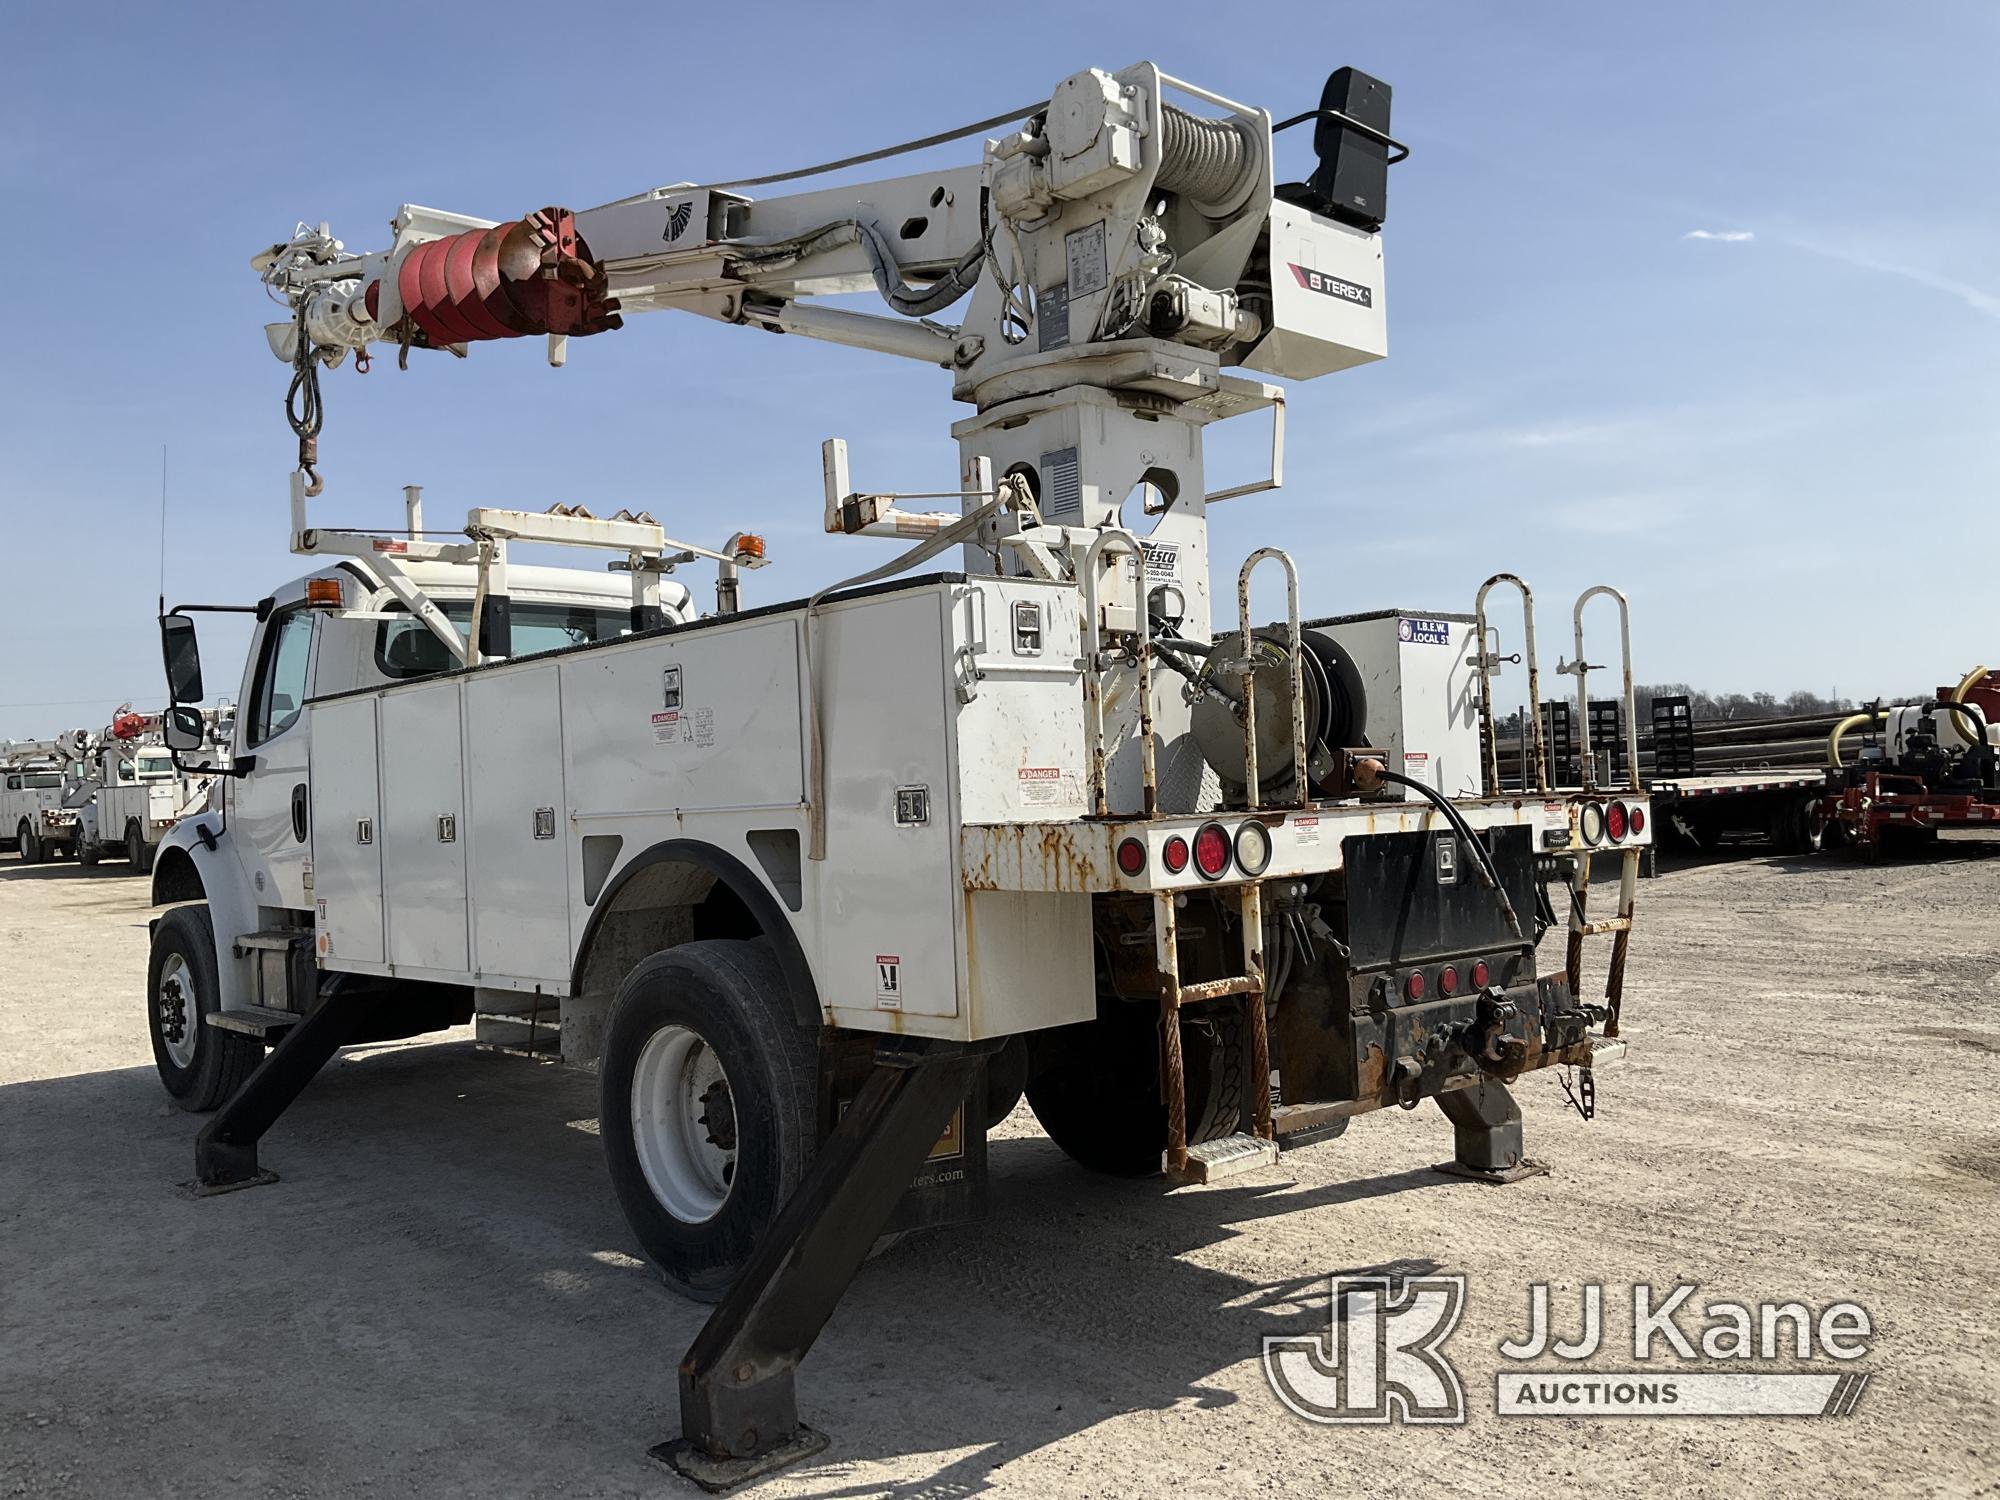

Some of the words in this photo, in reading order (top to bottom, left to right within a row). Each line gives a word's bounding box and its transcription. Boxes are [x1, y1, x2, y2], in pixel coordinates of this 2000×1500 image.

[1324, 277, 1363, 302] TEREX
[1417, 621, 1446, 633] I.B.E.W.
[1413, 632, 1439, 644] LOCAL
[657, 712, 678, 722] DANGER
[1028, 769, 1058, 779] DANGER
[1299, 818, 1318, 826] DANGER
